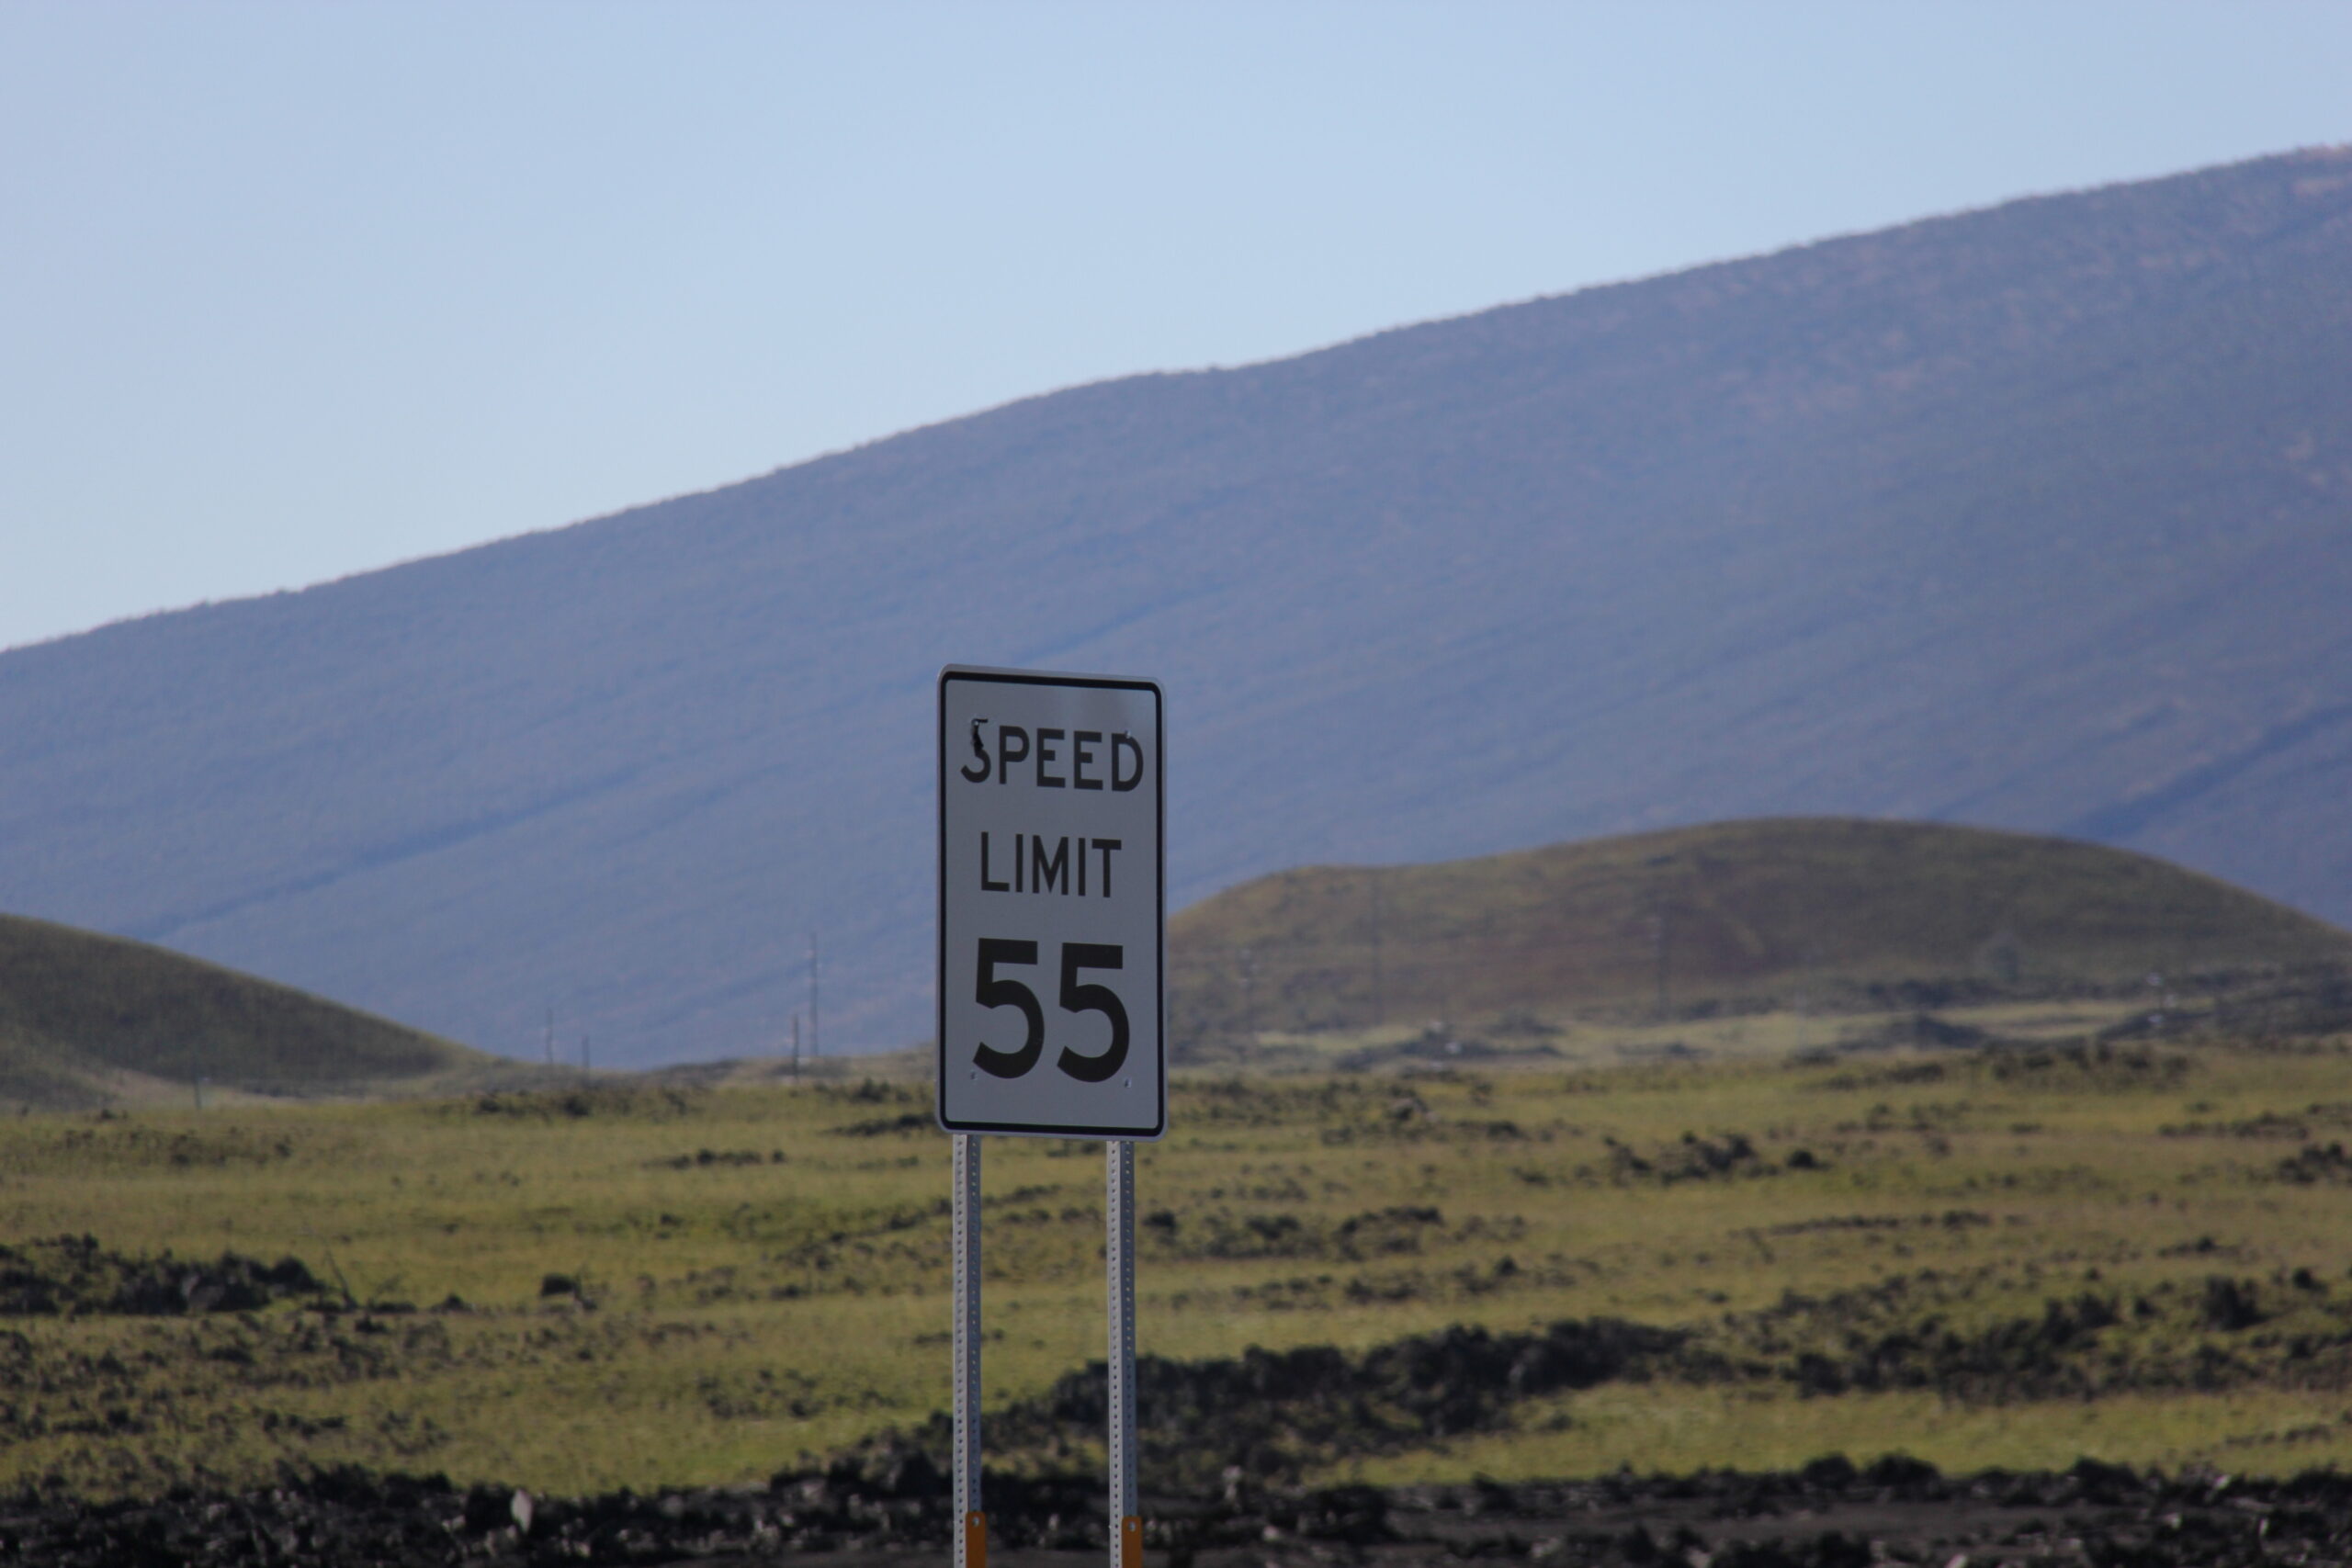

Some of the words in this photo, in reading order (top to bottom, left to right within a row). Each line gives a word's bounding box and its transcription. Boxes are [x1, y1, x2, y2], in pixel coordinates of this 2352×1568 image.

[960, 718, 1145, 792] SPEED
[980, 831, 1123, 898] LIMIT
[972, 938, 1130, 1084] 55
